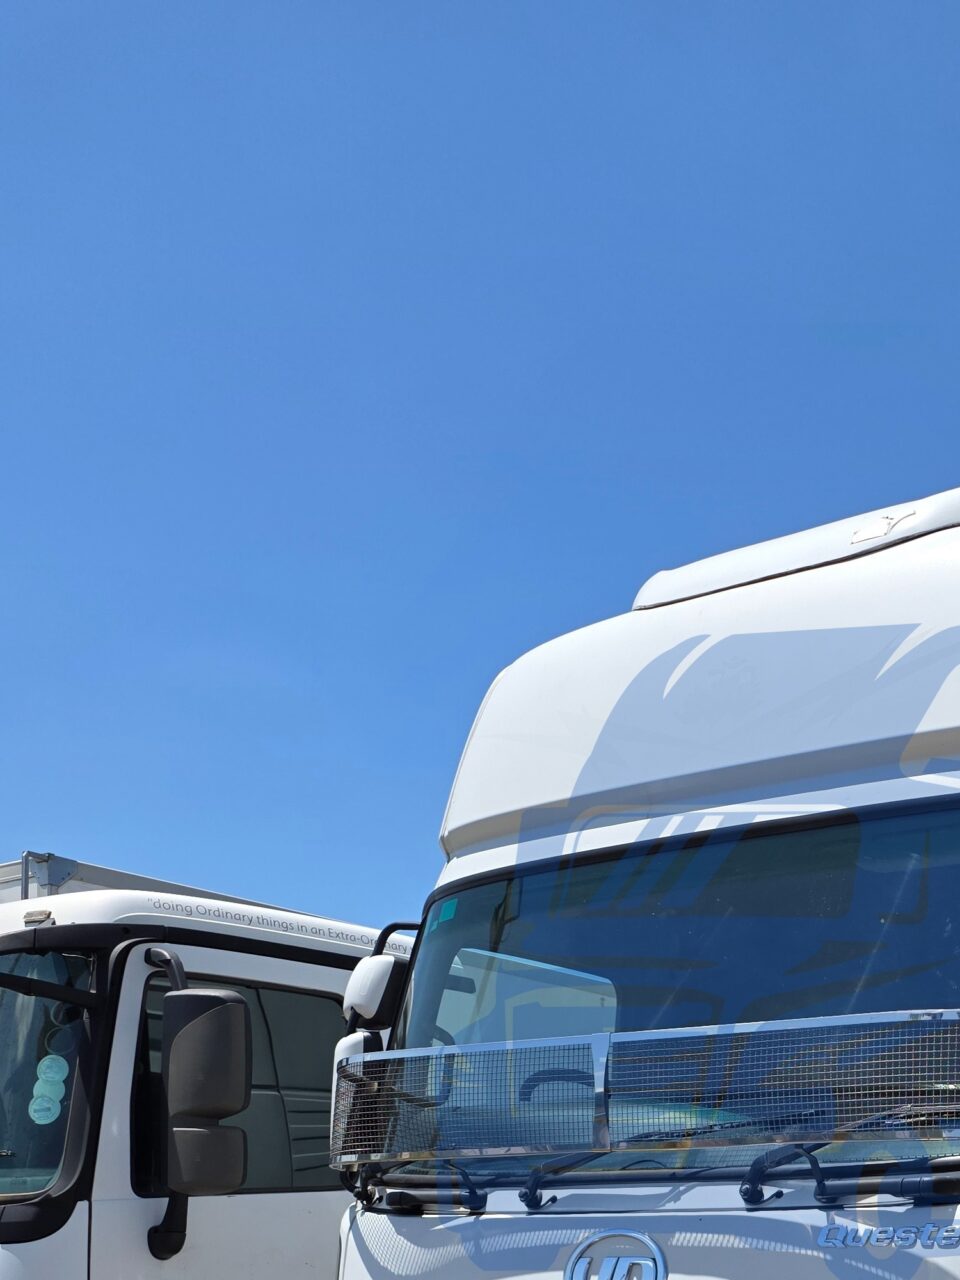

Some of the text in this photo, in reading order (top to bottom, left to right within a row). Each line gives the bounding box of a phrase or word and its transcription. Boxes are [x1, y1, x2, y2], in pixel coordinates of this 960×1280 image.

[195, 903, 254, 926] Ordinary
[256, 913, 294, 932] things
[297, 920, 308, 933] in
[310, 926, 326, 937] an
